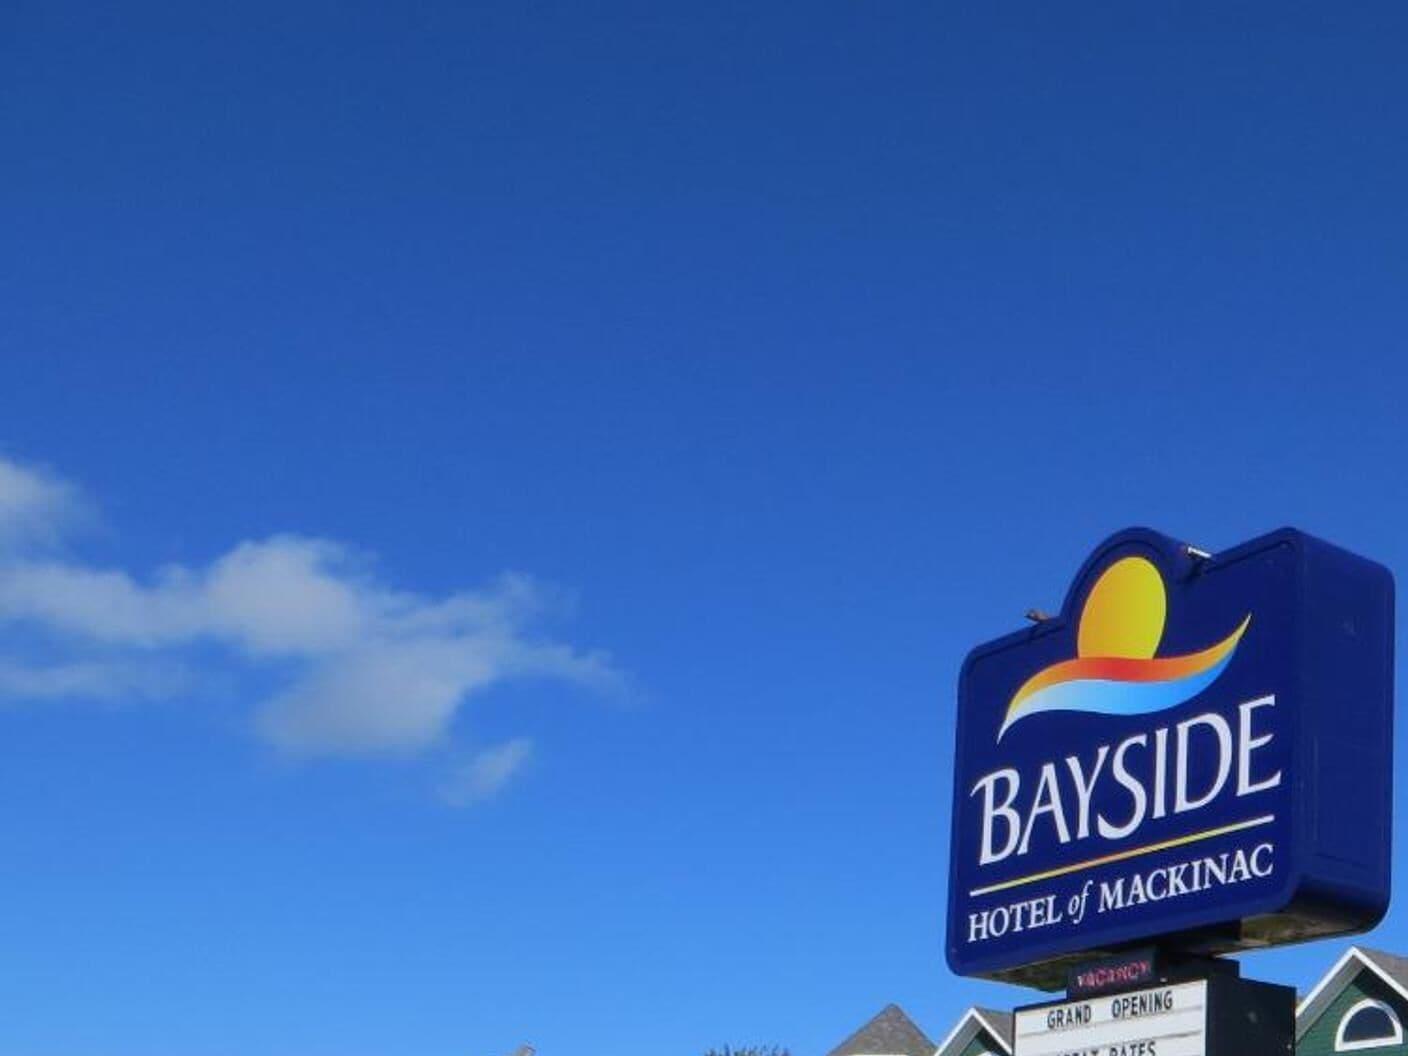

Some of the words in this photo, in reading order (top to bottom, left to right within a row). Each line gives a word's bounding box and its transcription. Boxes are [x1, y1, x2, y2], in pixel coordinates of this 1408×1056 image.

[970, 694, 1282, 866] BAYSIDE
[968, 894, 1062, 943] HOTEL
[1067, 879, 1094, 924] of
[1098, 844, 1274, 913] MACKINAC
[1047, 1004, 1092, 1029] GRAND
[1111, 990, 1173, 1019] OPENING
